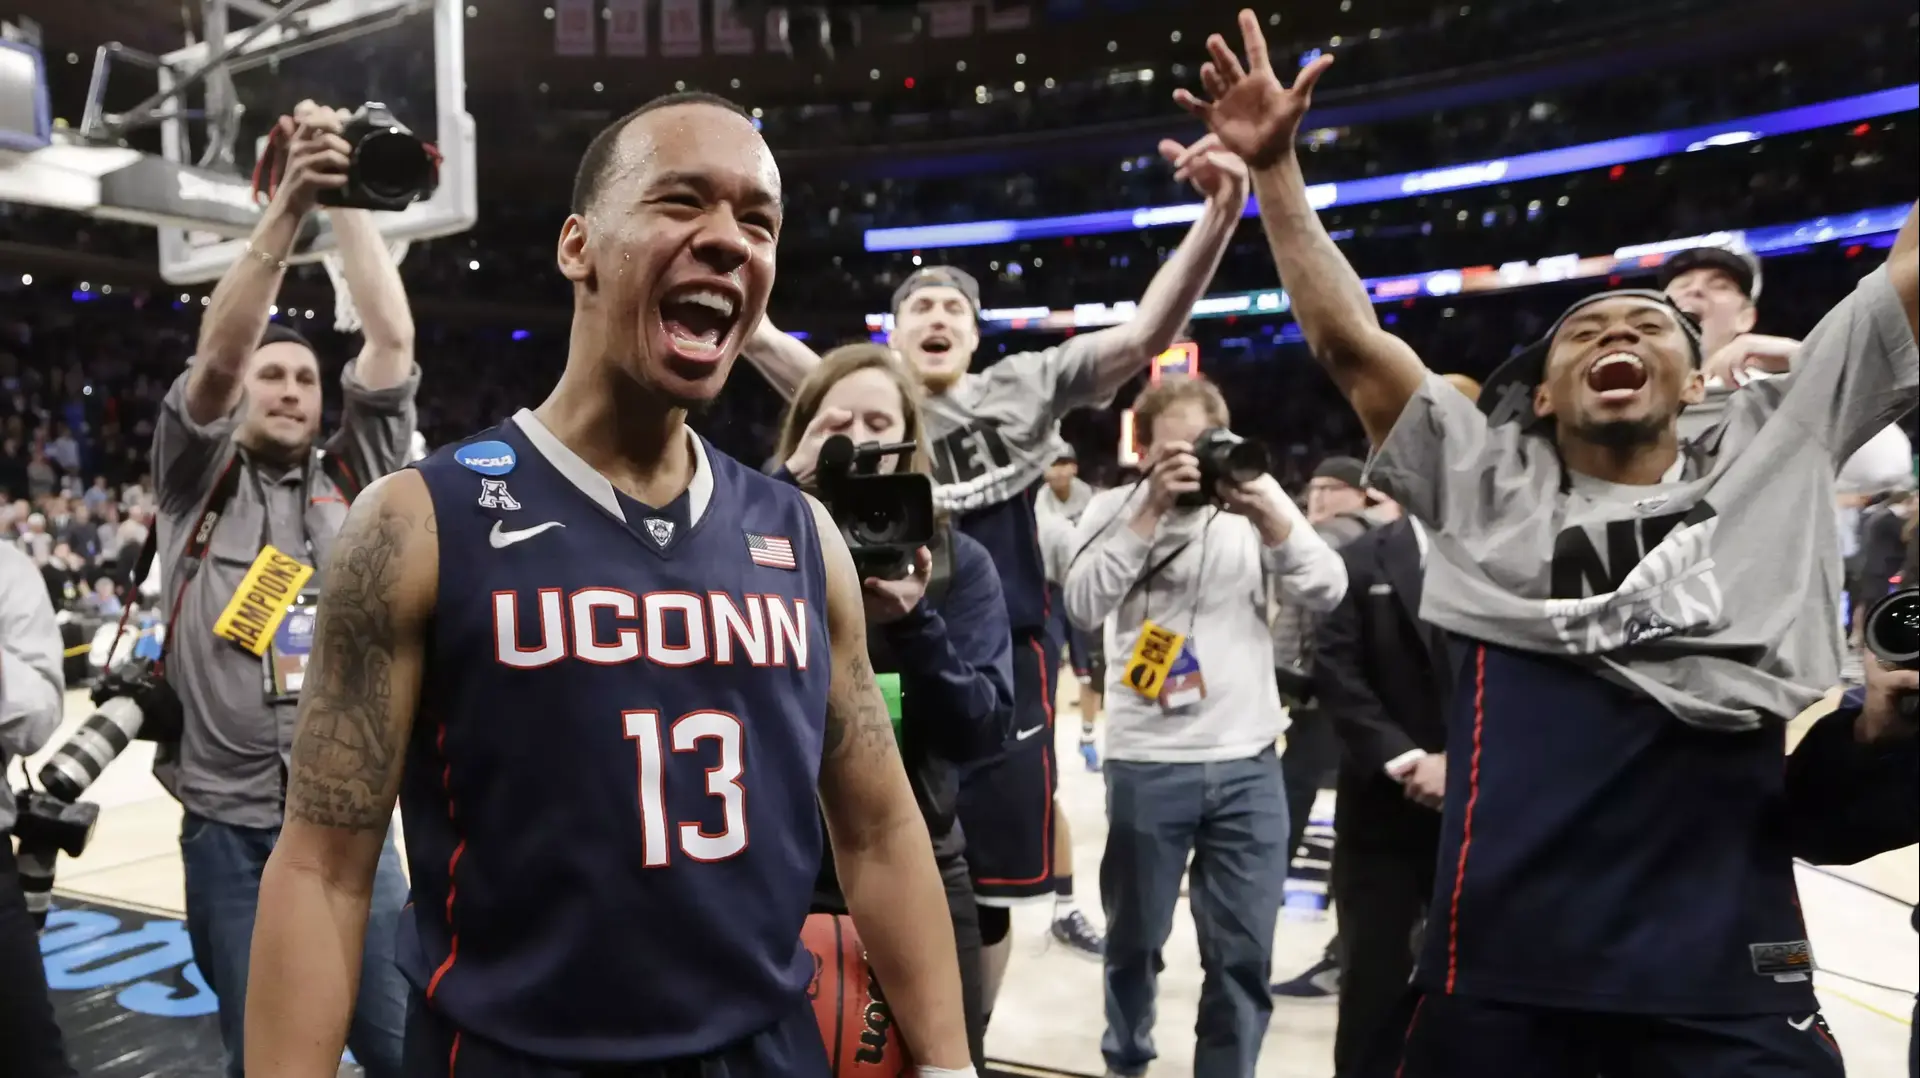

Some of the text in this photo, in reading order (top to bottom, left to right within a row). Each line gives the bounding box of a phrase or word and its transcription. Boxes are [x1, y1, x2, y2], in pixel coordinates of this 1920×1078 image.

[465, 455, 514, 467] NCAA
[492, 587, 808, 670] UCONN
[621, 709, 748, 868] 13
